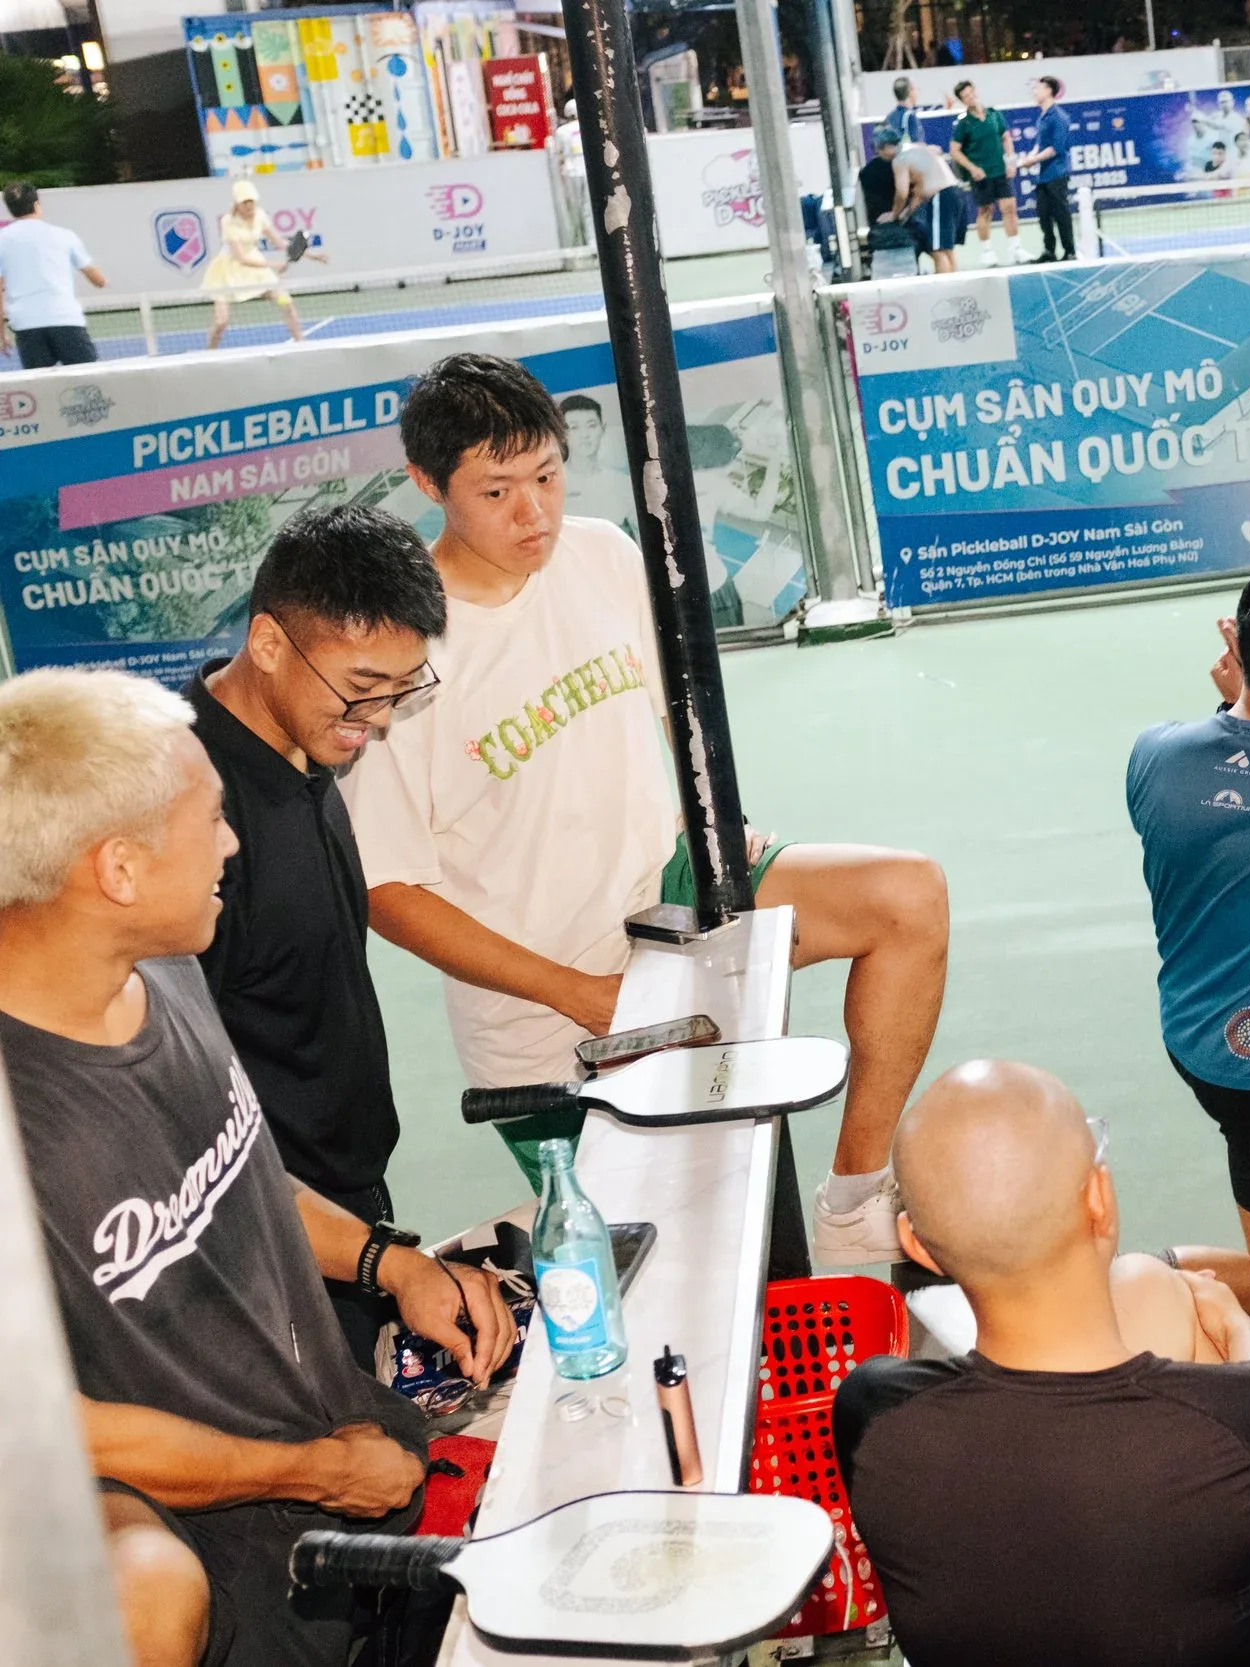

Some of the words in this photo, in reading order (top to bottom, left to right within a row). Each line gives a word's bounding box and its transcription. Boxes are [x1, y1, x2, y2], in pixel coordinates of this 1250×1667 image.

[433, 223, 486, 241] D-JOY
[863, 338, 909, 354] D-JOY
[878, 392, 967, 441] CỤM
[975, 378, 1064, 425] SÂN
[1072, 372, 1153, 418] QUY
[1164, 358, 1224, 404] MÔ
[133, 397, 367, 469] PICKLEBALL
[886, 424, 1066, 500] CHUẨN
[1077, 412, 1215, 483] QUỐC
[170, 467, 235, 503] NAM
[239, 455, 287, 490] SÀI
[292, 446, 352, 480] GÒN
[14, 547, 70, 577] CỤM
[74, 538, 128, 567] SÂN
[135, 534, 182, 562] QUY
[188, 526, 227, 555] MÔ
[952, 536, 1028, 558] Pickleball
[1032, 530, 1080, 549] D-JOY
[1084, 526, 1121, 543] Nam
[1151, 518, 1184, 535] Gòn
[22, 560, 135, 611] CHUẨN
[139, 558, 226, 602] QUỐC
[936, 566, 945, 578] 2
[986, 571, 1014, 586] HCM
[93, 1055, 258, 1287] Dreamvill
